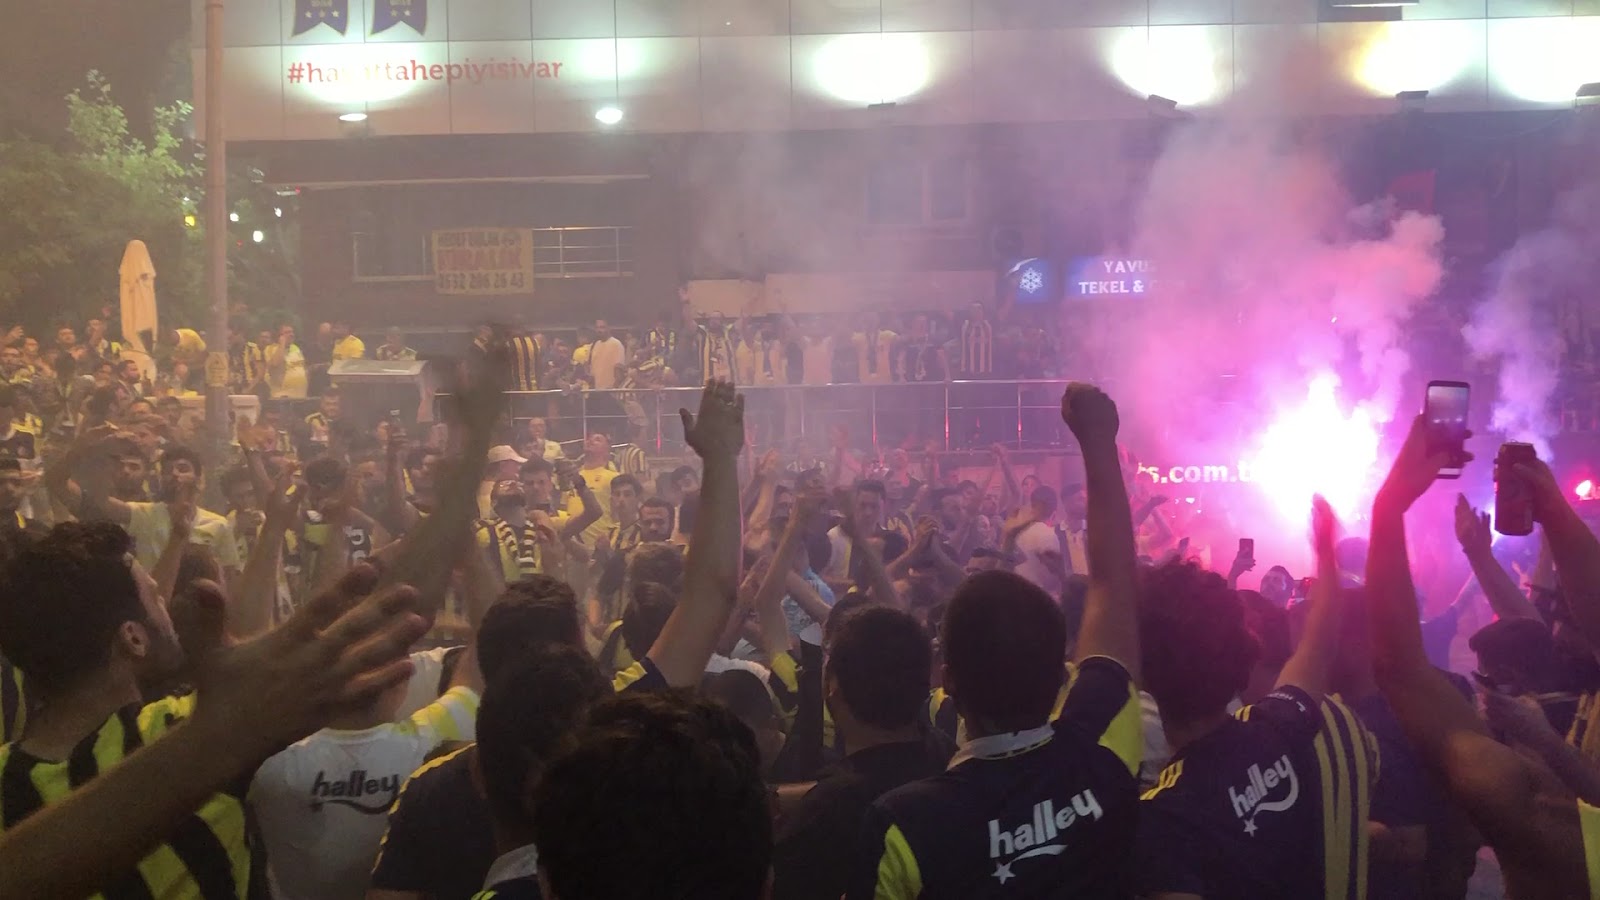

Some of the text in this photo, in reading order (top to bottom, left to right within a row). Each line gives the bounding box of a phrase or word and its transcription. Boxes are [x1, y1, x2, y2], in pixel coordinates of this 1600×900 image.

[1078, 281, 1130, 295] TEKEL
[1133, 279, 1145, 293] &
[1104, 260, 1155, 274] YAVU
[311, 769, 400, 809] halley
[1228, 755, 1299, 818] halley
[988, 788, 1103, 858] halley
